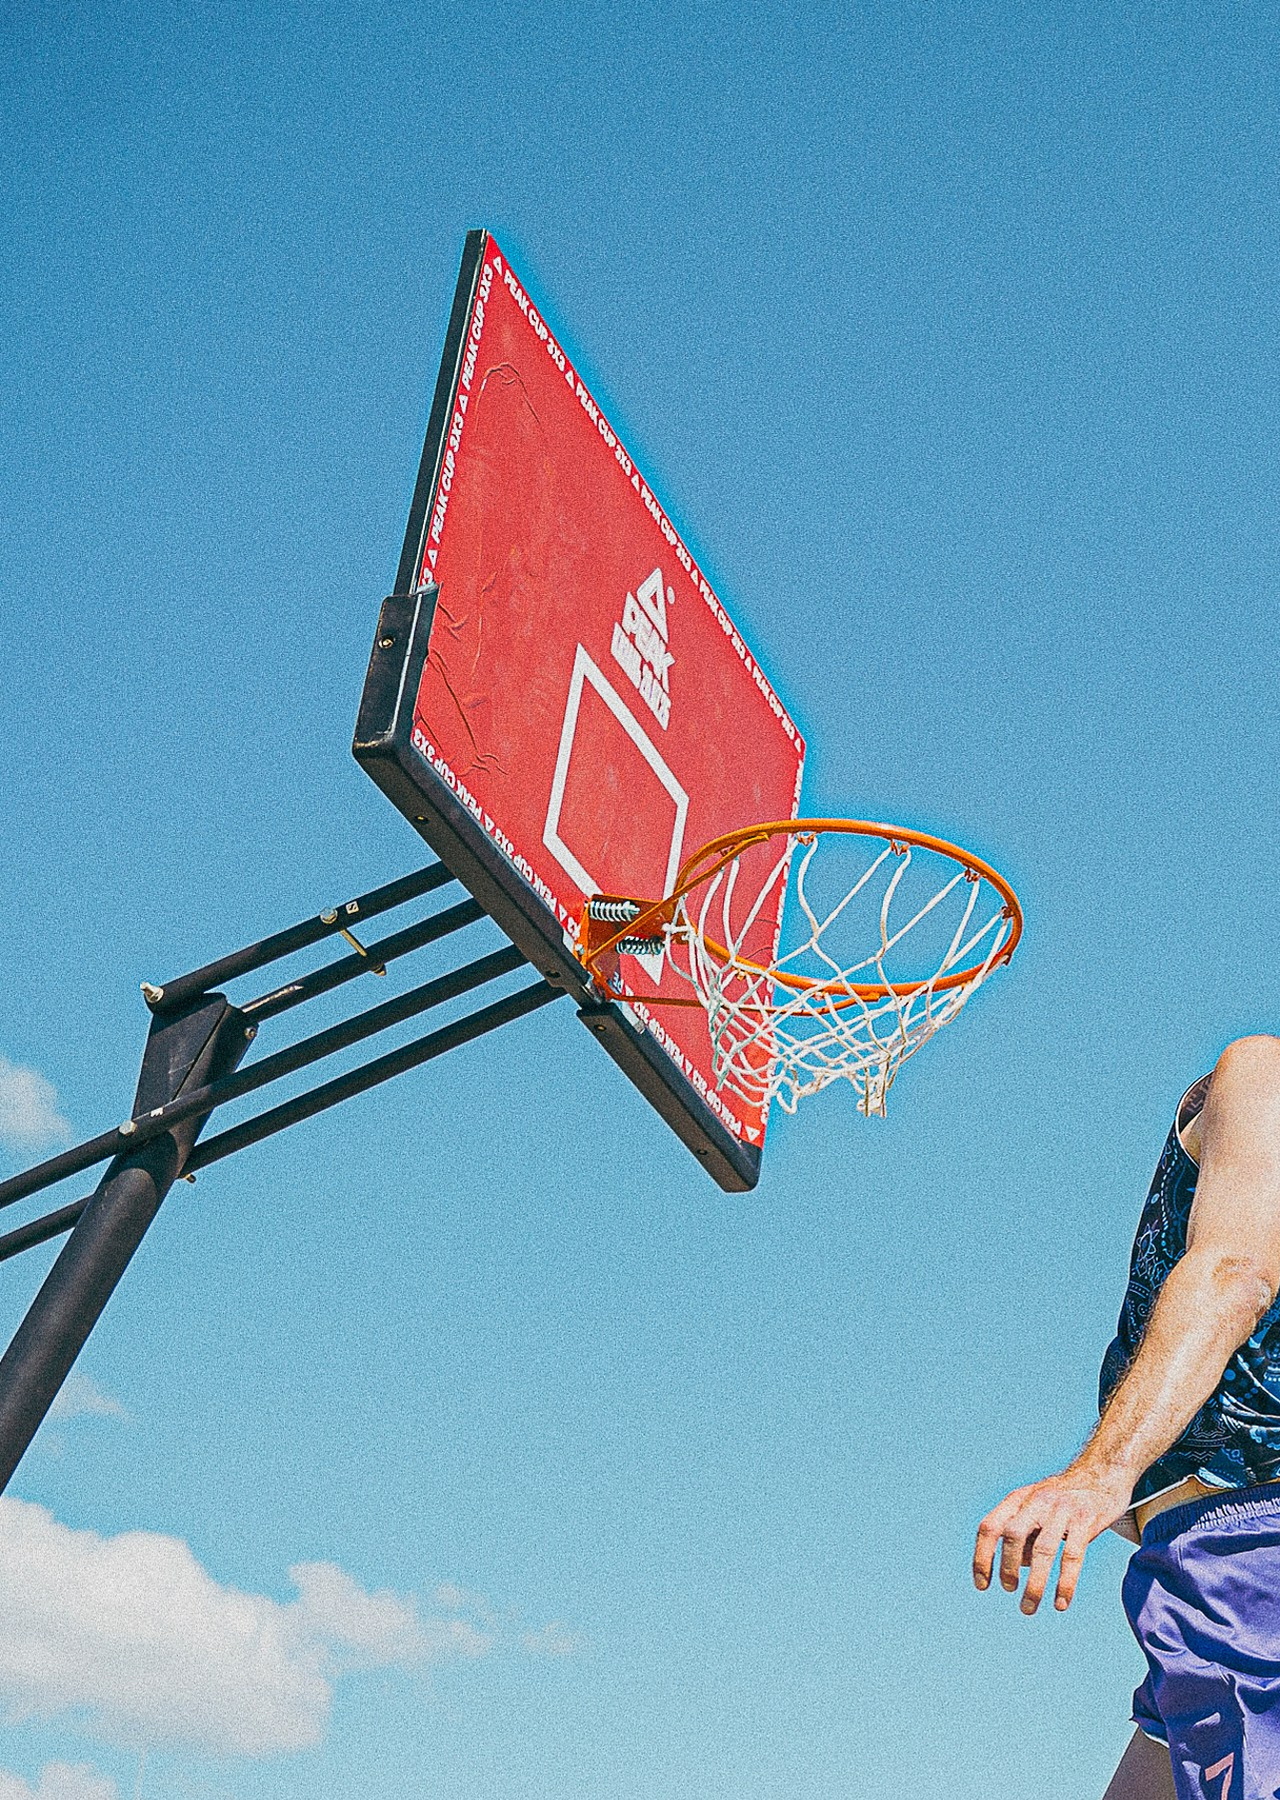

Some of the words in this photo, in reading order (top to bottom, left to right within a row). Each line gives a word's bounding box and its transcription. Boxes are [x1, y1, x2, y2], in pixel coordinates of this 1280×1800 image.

[431, 489, 449, 544] PEAK
[442, 450, 455, 491] CUP
[450, 412, 464, 453] 3X3
[461, 337, 479, 391] PEAK
[471, 300, 485, 340] CUP
[479, 263, 493, 303] 3X3
[504, 269, 529, 316] PEAK
[528, 308, 548, 341] CUP
[546, 337, 565, 372] 3X3
[575, 382, 599, 426] PEAK
[598, 418, 616, 447] CUP
[640, 485, 662, 525] PEAK
[660, 517, 677, 545] CUP
[621, 591, 675, 693] PEAK
[414, 728, 435, 763] 3X3
[433, 758, 455, 788] CUP
[456, 779, 482, 820] PEAK
[513, 854, 533, 881] CUP
[532, 873, 557, 912] PEAK
